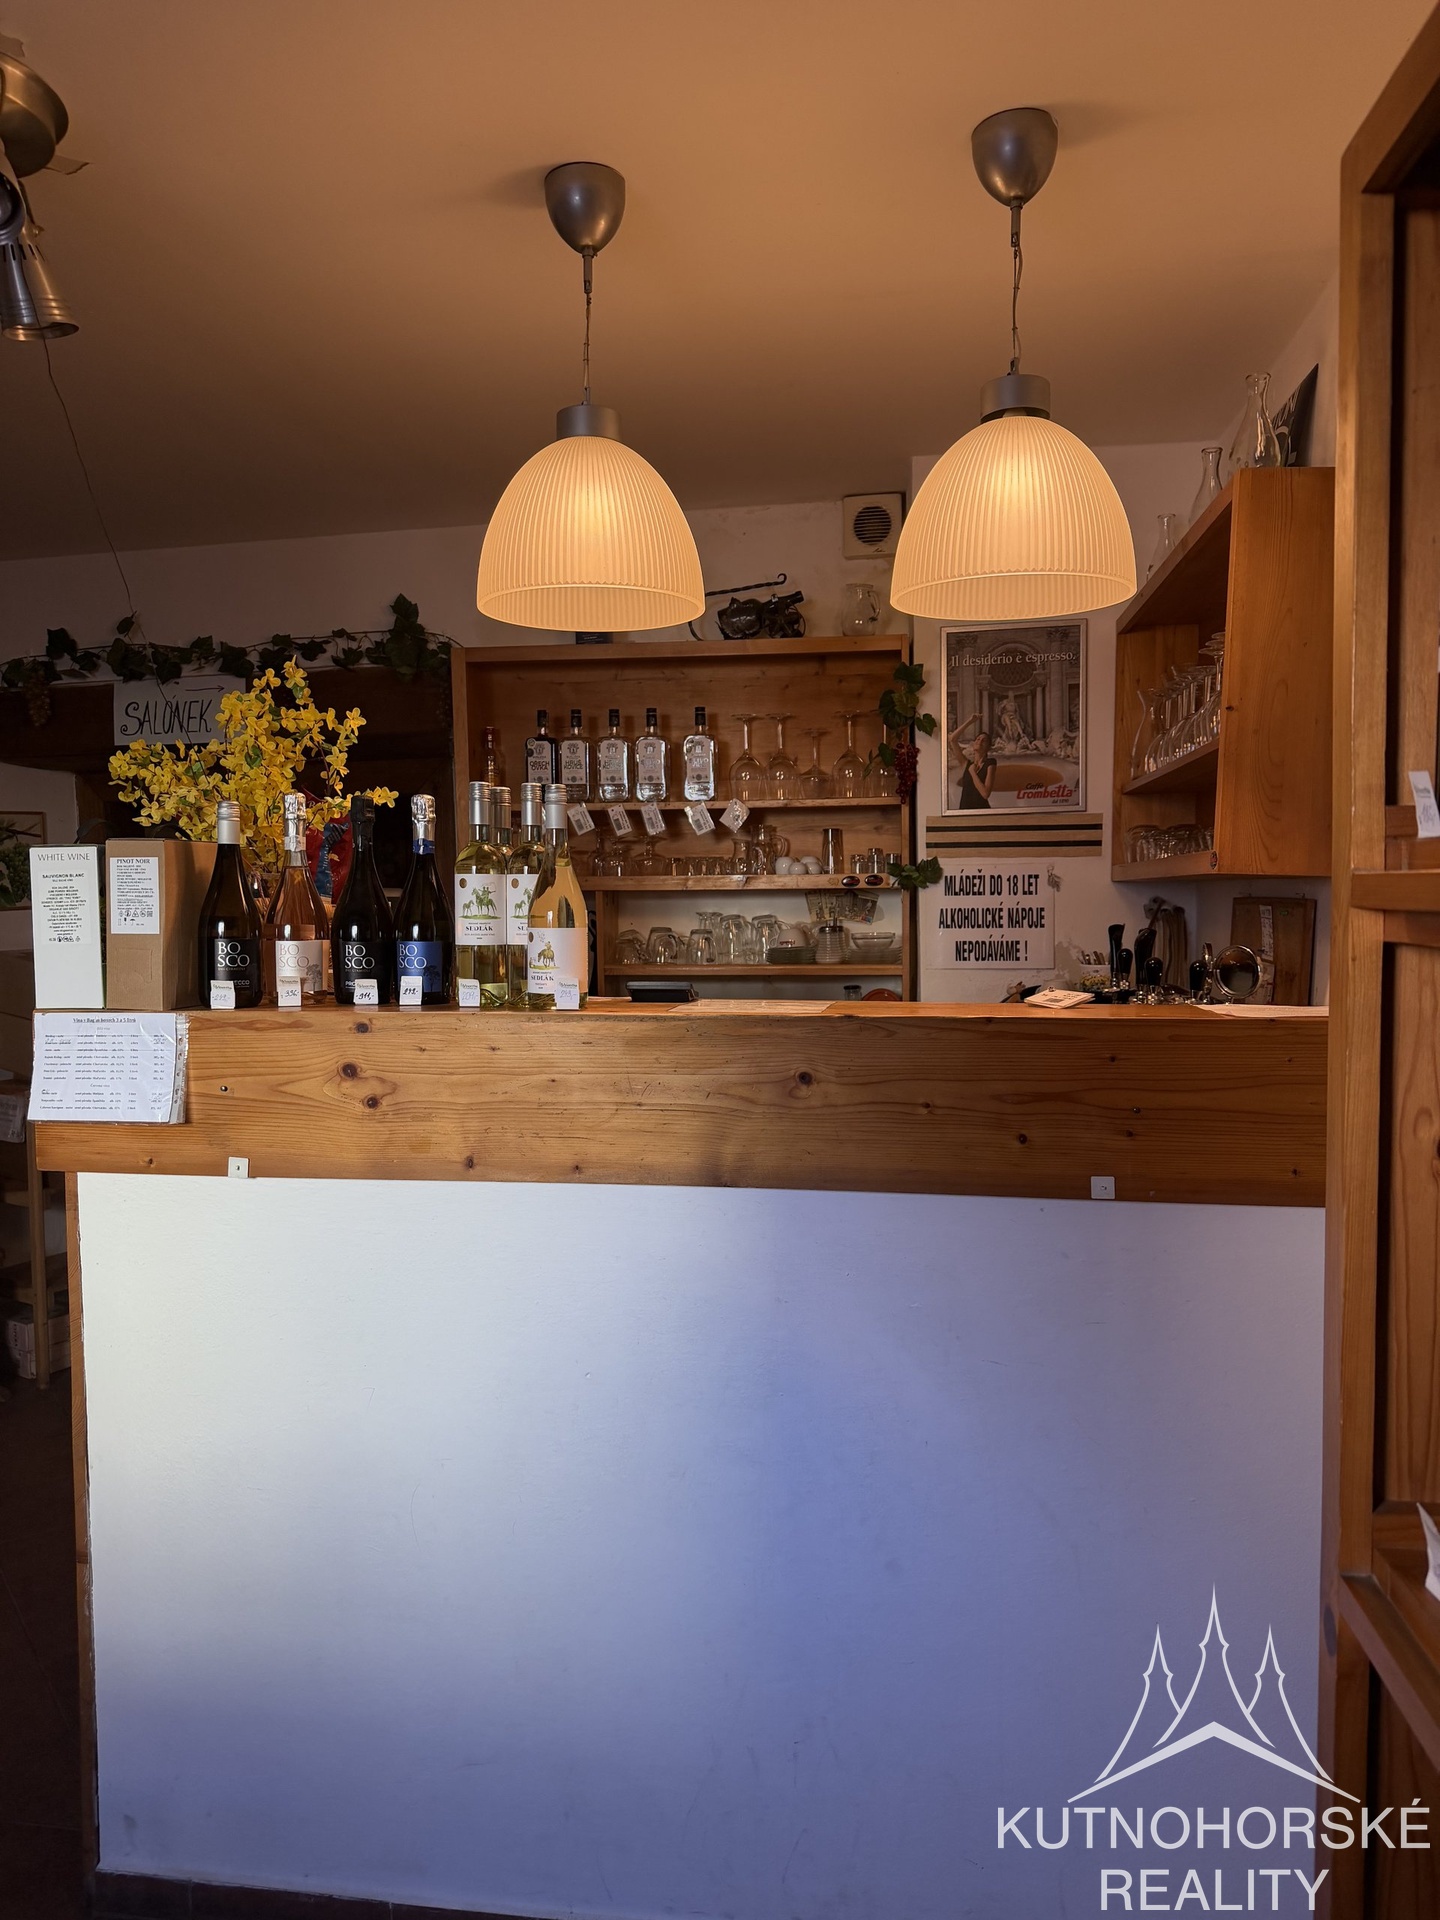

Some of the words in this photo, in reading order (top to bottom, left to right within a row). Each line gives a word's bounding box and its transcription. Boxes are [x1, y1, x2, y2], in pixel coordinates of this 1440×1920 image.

[951, 655, 958, 667] Il
[962, 653, 1012, 666] desiderio
[1016, 652, 1022, 664] è
[1026, 651, 1076, 666] espresso.
[120, 695, 213, 736] SALÓNEK
[38, 853, 64, 861] WHITE
[67, 852, 90, 860] WINE
[944, 869, 986, 896] MLÁDEŽI
[990, 874, 1002, 896] DO
[1006, 874, 1018, 896] 18
[1022, 874, 1040, 896] LET
[938, 901, 1004, 929] ALKOHOLICKÉ
[1008, 901, 1046, 928] NÁPOJE
[217, 942, 241, 955] BO
[280, 944, 300, 956] BO
[345, 944, 366, 957] BO
[400, 944, 418, 957] BO
[955, 934, 1020, 962] NEPODÁVÁME
[1024, 940, 1028, 962] !
[217, 954, 250, 968] SCO
[279, 956, 310, 968] SCO
[344, 956, 375, 969] SCO
[400, 956, 427, 969] SCO
